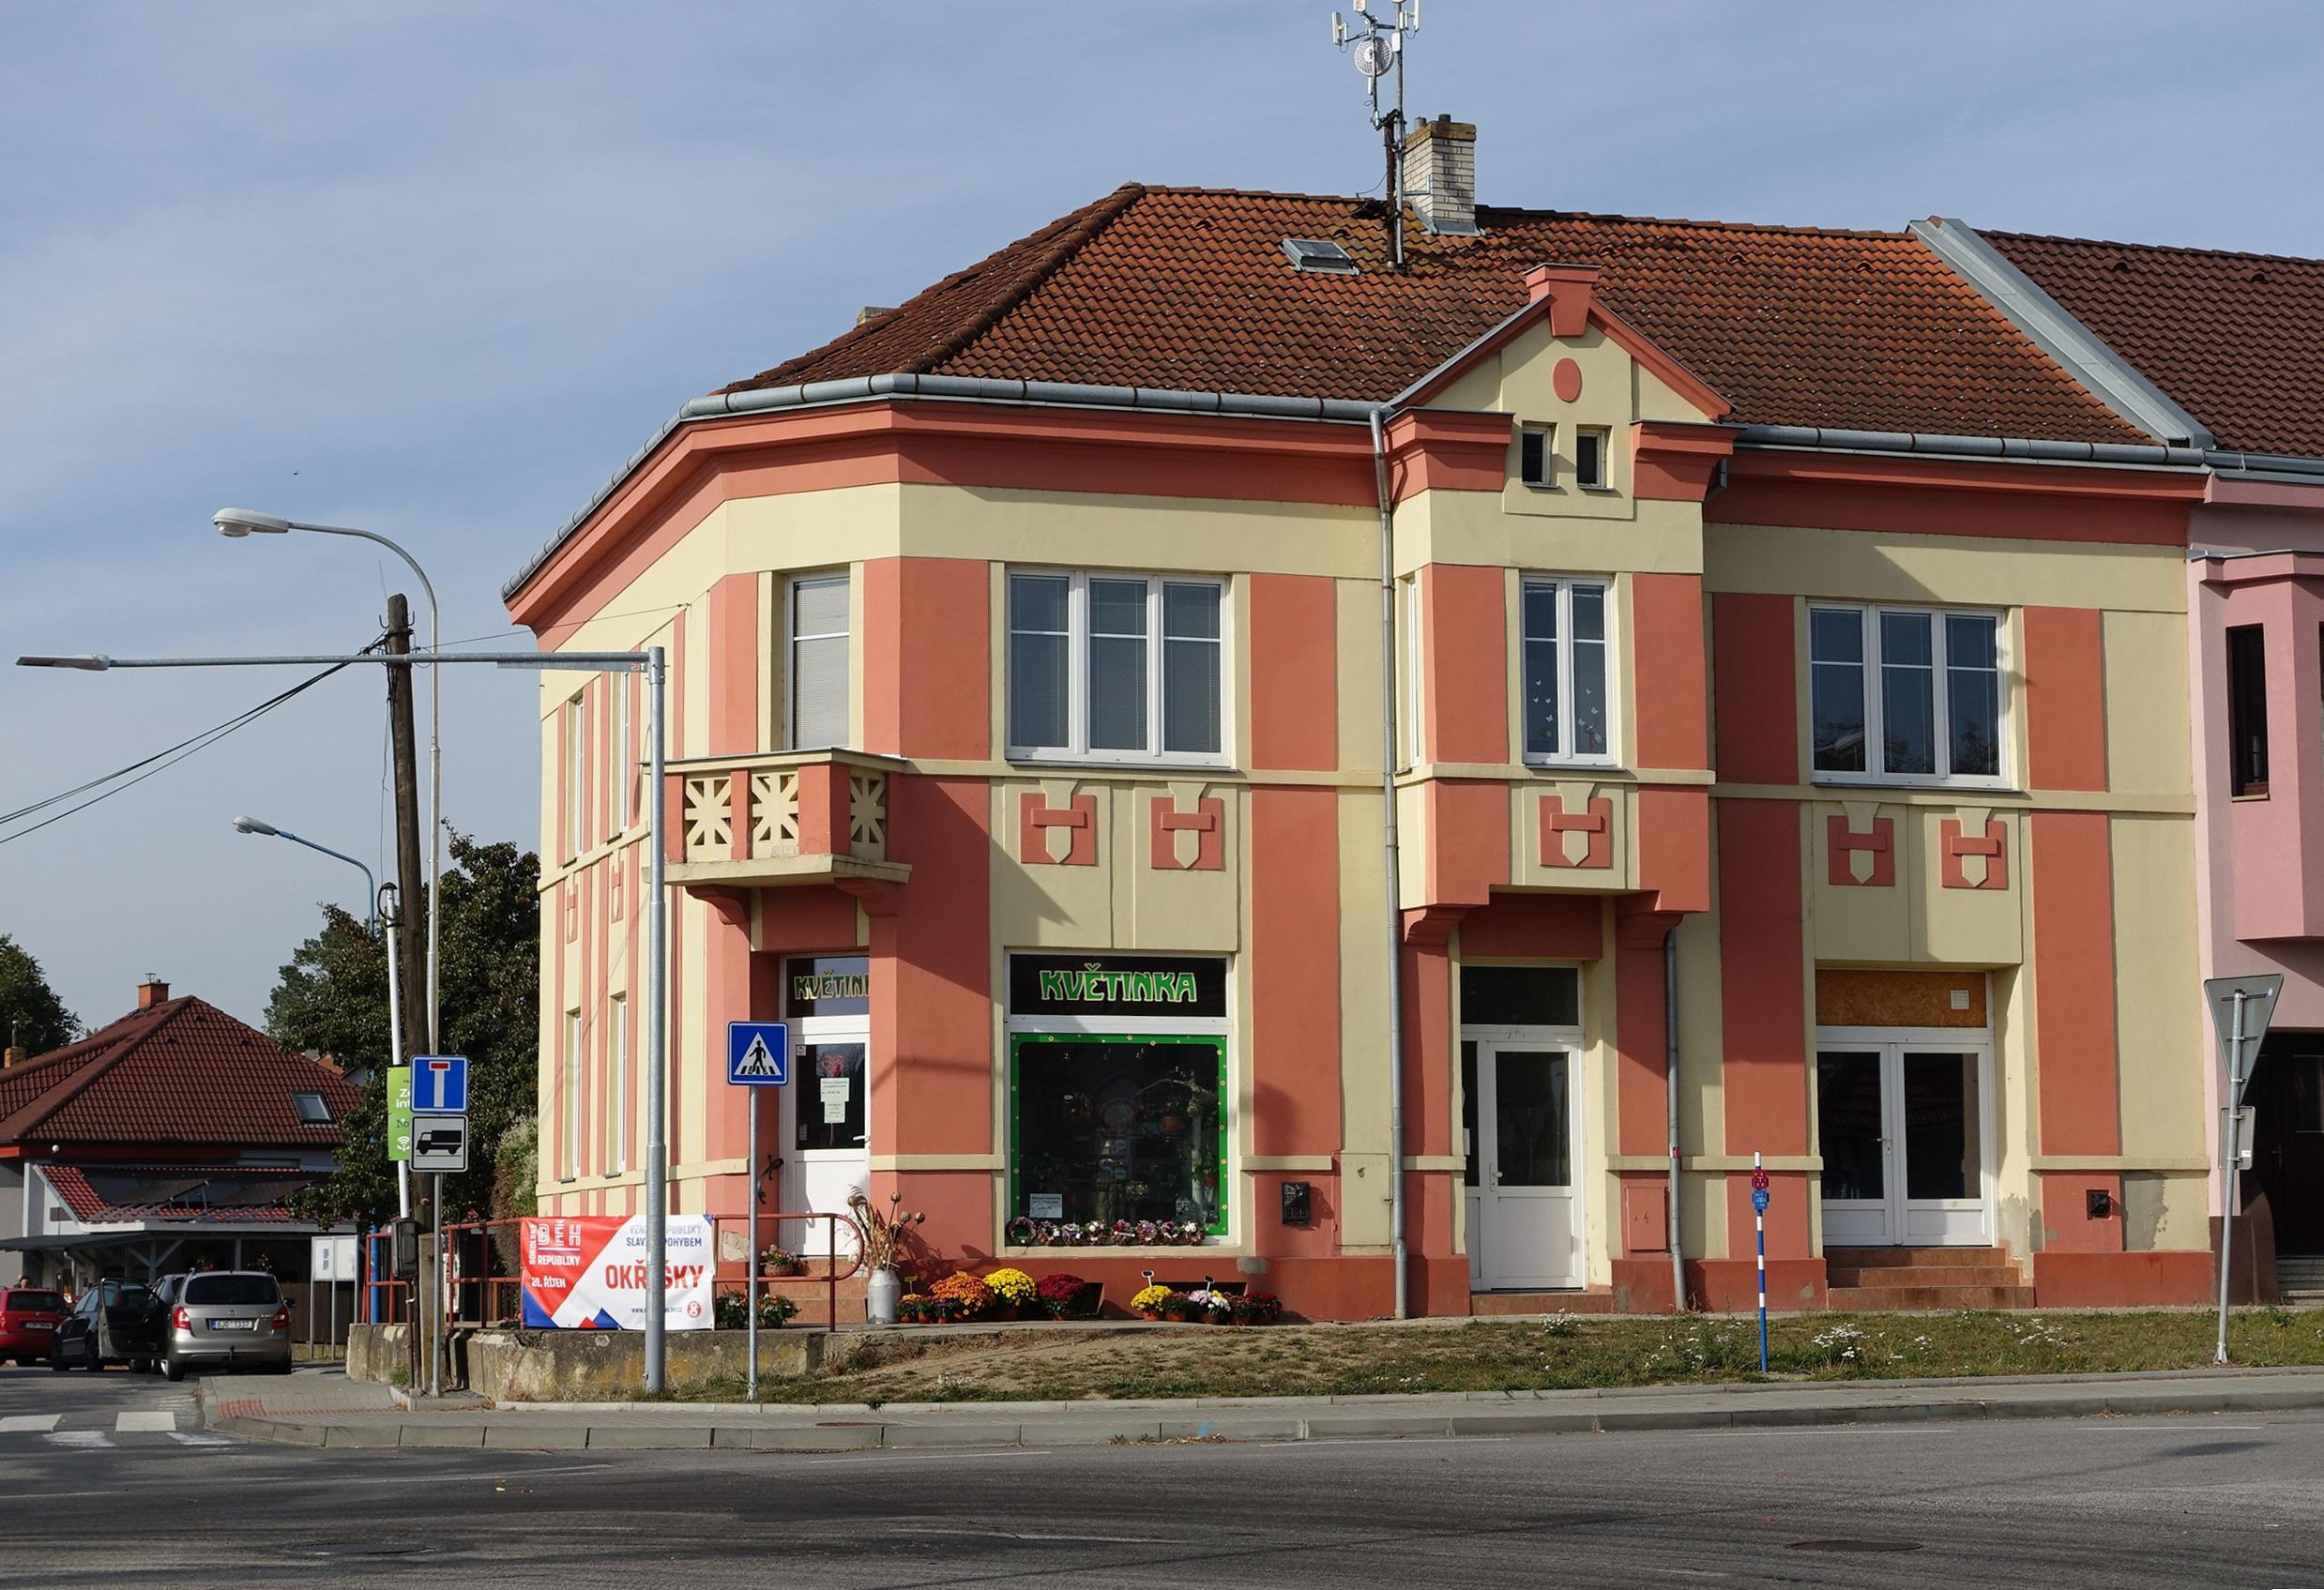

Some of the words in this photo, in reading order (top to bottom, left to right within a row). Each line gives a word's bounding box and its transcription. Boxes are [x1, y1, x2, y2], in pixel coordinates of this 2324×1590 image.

[1040, 963, 1197, 1003] KVĚTINKA
[626, 1236, 646, 1247] SLAV
[538, 1254, 581, 1266] REPUBLIKY
[605, 1259, 704, 1290] OKŘŠKY
